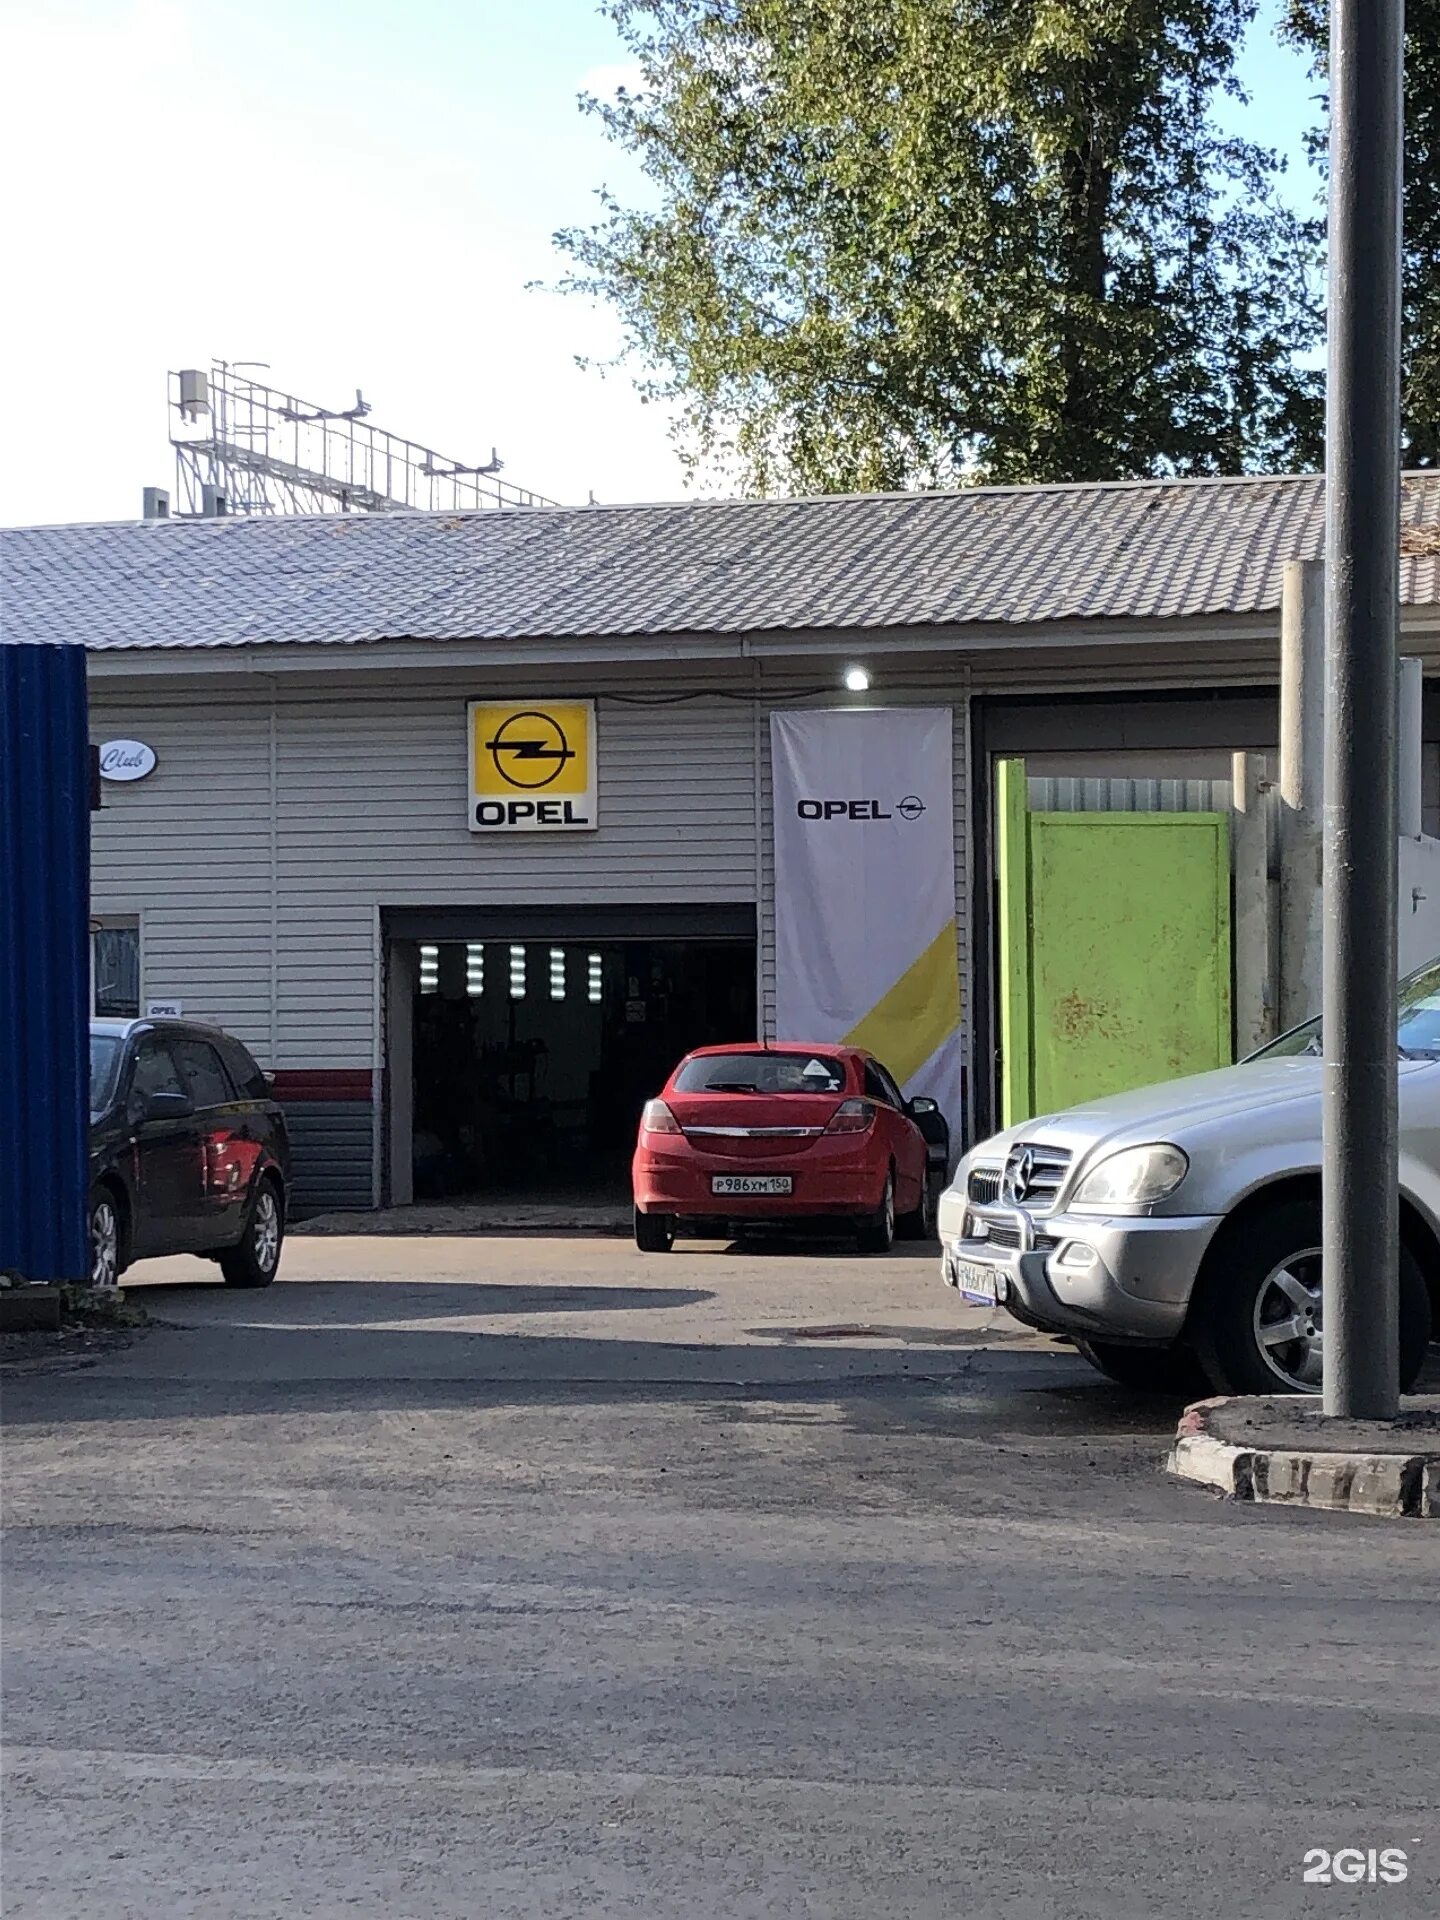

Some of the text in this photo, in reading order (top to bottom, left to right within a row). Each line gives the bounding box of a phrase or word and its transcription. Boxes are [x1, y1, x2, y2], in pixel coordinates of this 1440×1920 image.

[101, 748, 146, 772] Club
[475, 800, 589, 826] OPEL
[797, 799, 892, 820] OPEL
